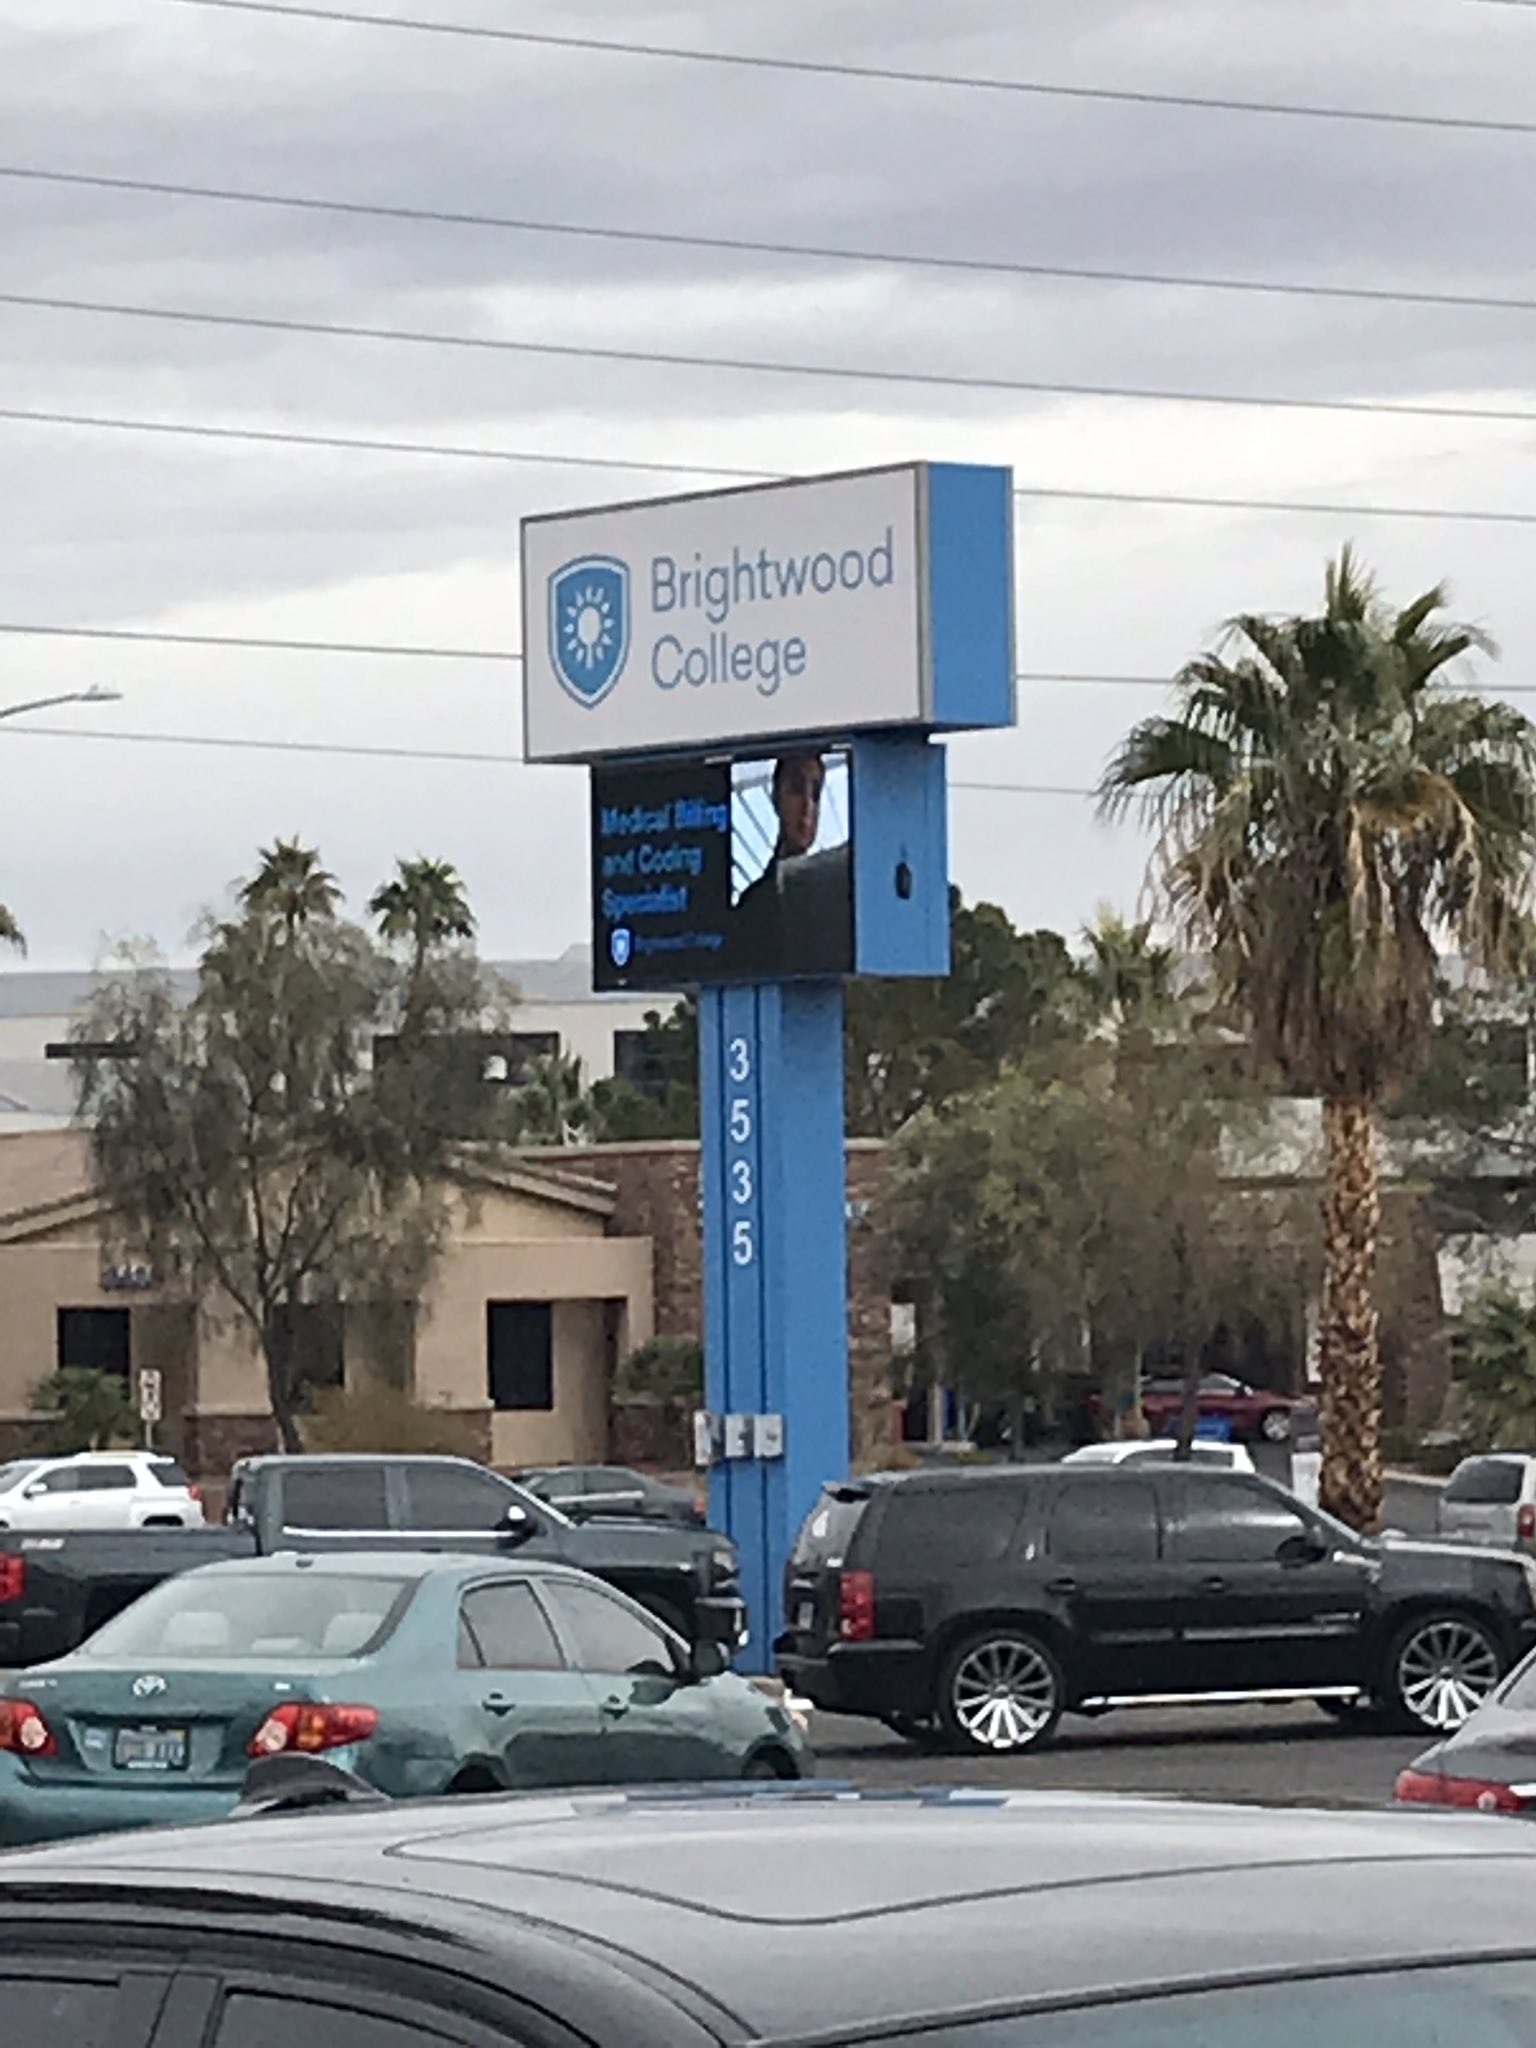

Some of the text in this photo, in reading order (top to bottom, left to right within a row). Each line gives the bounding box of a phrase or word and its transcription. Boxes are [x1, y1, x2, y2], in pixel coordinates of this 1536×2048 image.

[652, 526, 893, 624] Brightwood
[652, 631, 806, 697] College
[602, 804, 670, 835] Medical
[603, 844, 702, 876] and Coding
[729, 1038, 753, 1265] 3535
